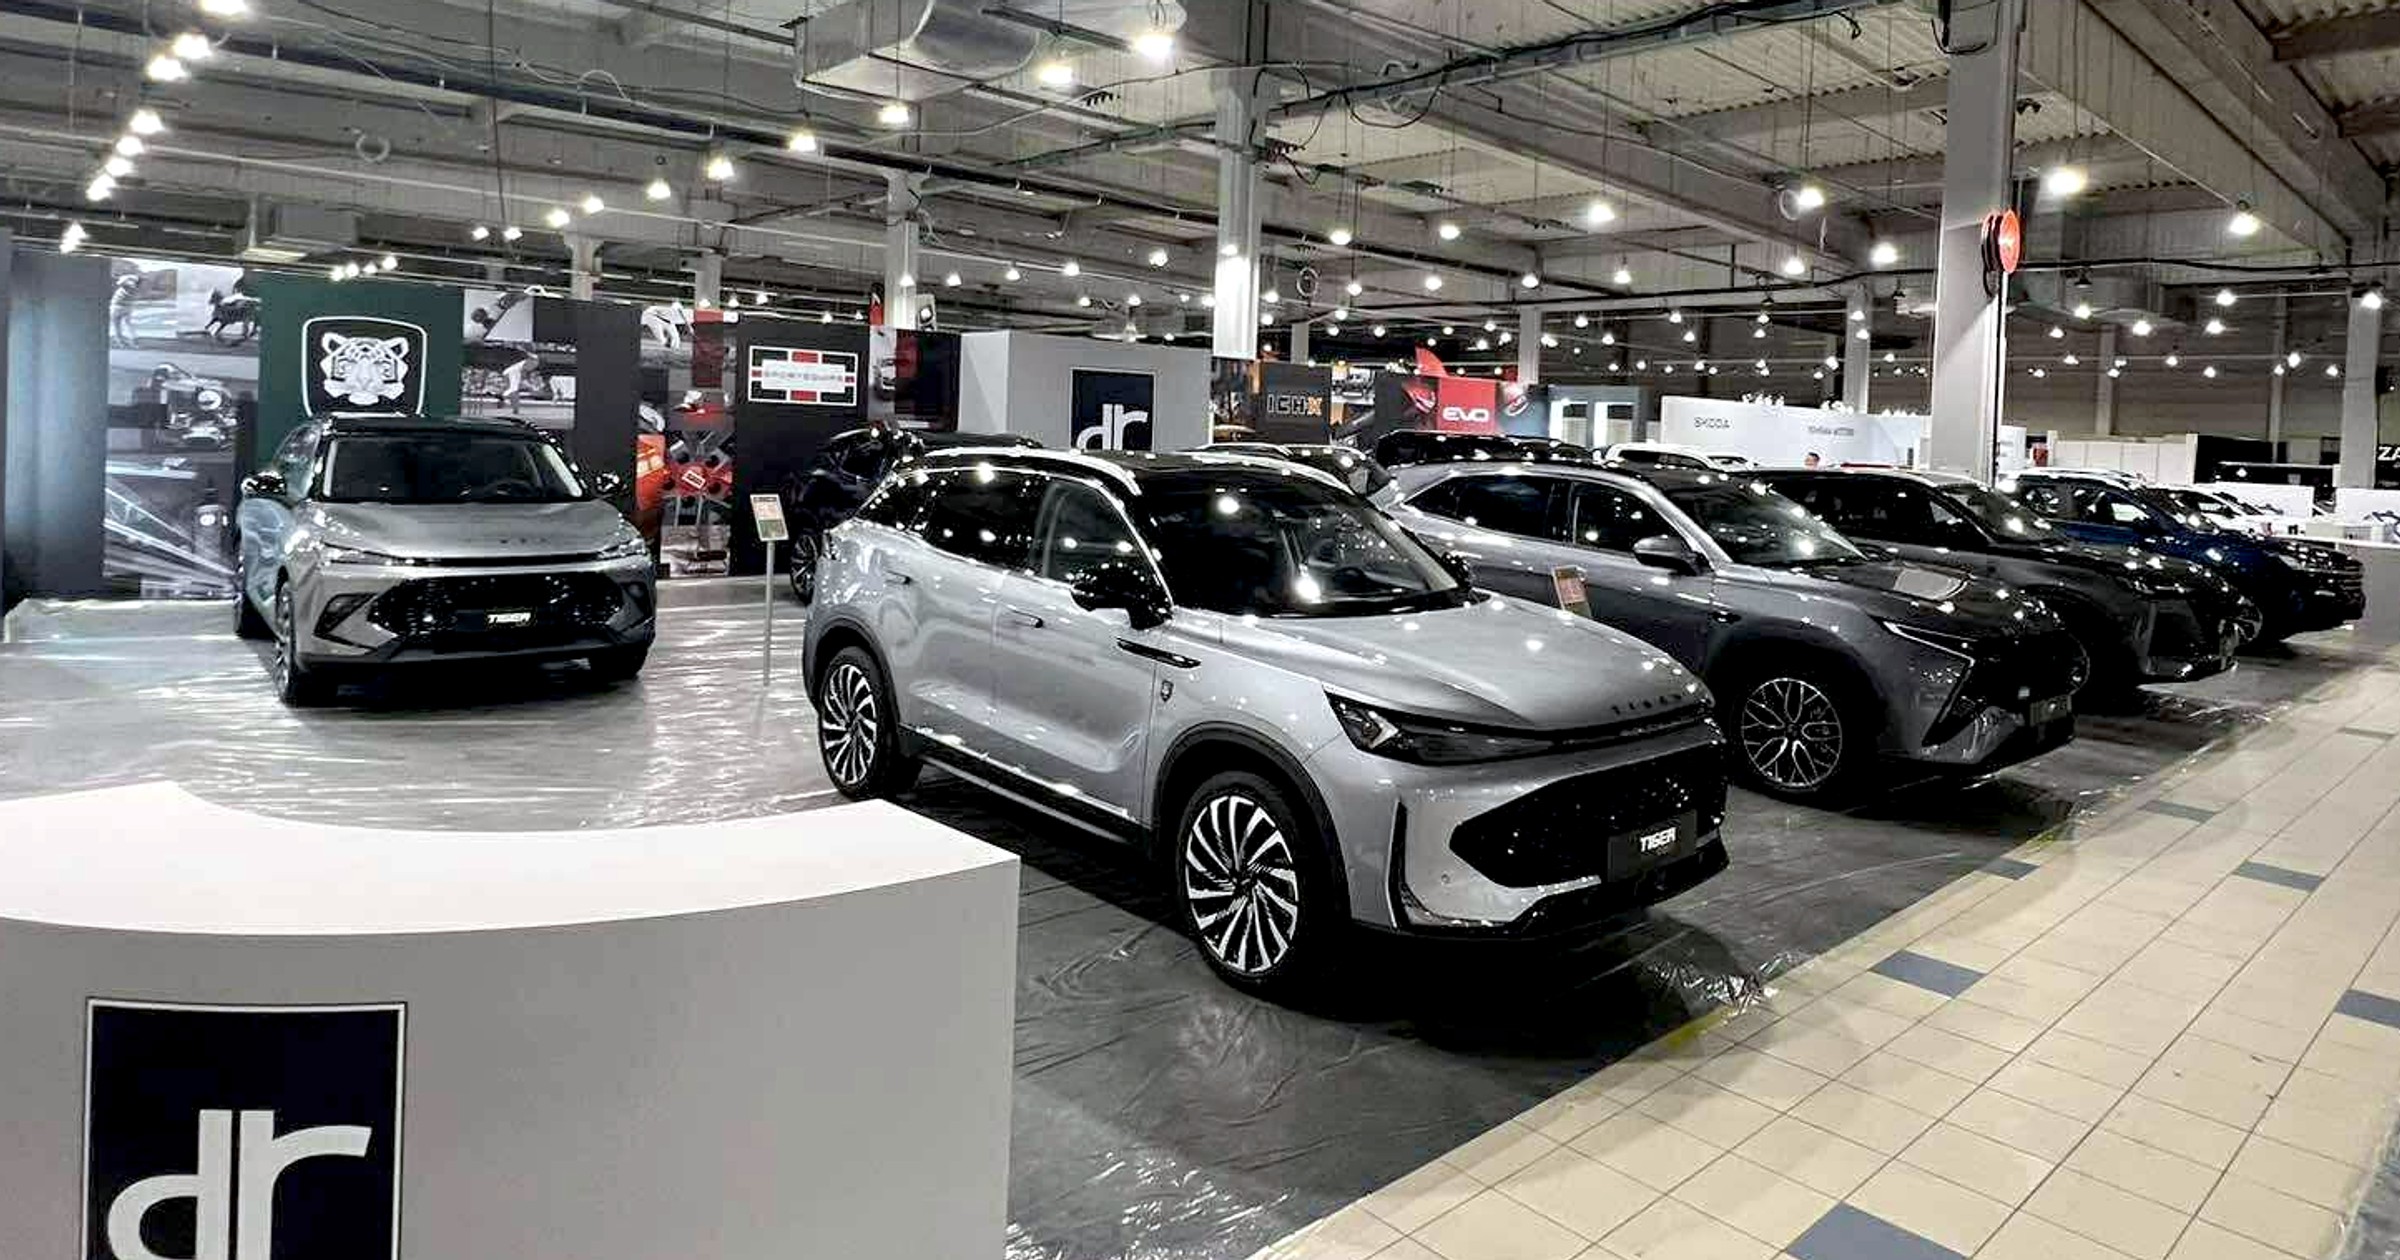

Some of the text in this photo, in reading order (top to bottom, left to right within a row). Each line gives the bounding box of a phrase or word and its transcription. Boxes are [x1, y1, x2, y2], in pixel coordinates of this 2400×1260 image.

[1076, 403, 1148, 450] dr
[1442, 406, 1489, 422] EVO
[1640, 827, 1676, 852] TIGER
[107, 1109, 372, 1260] dr
